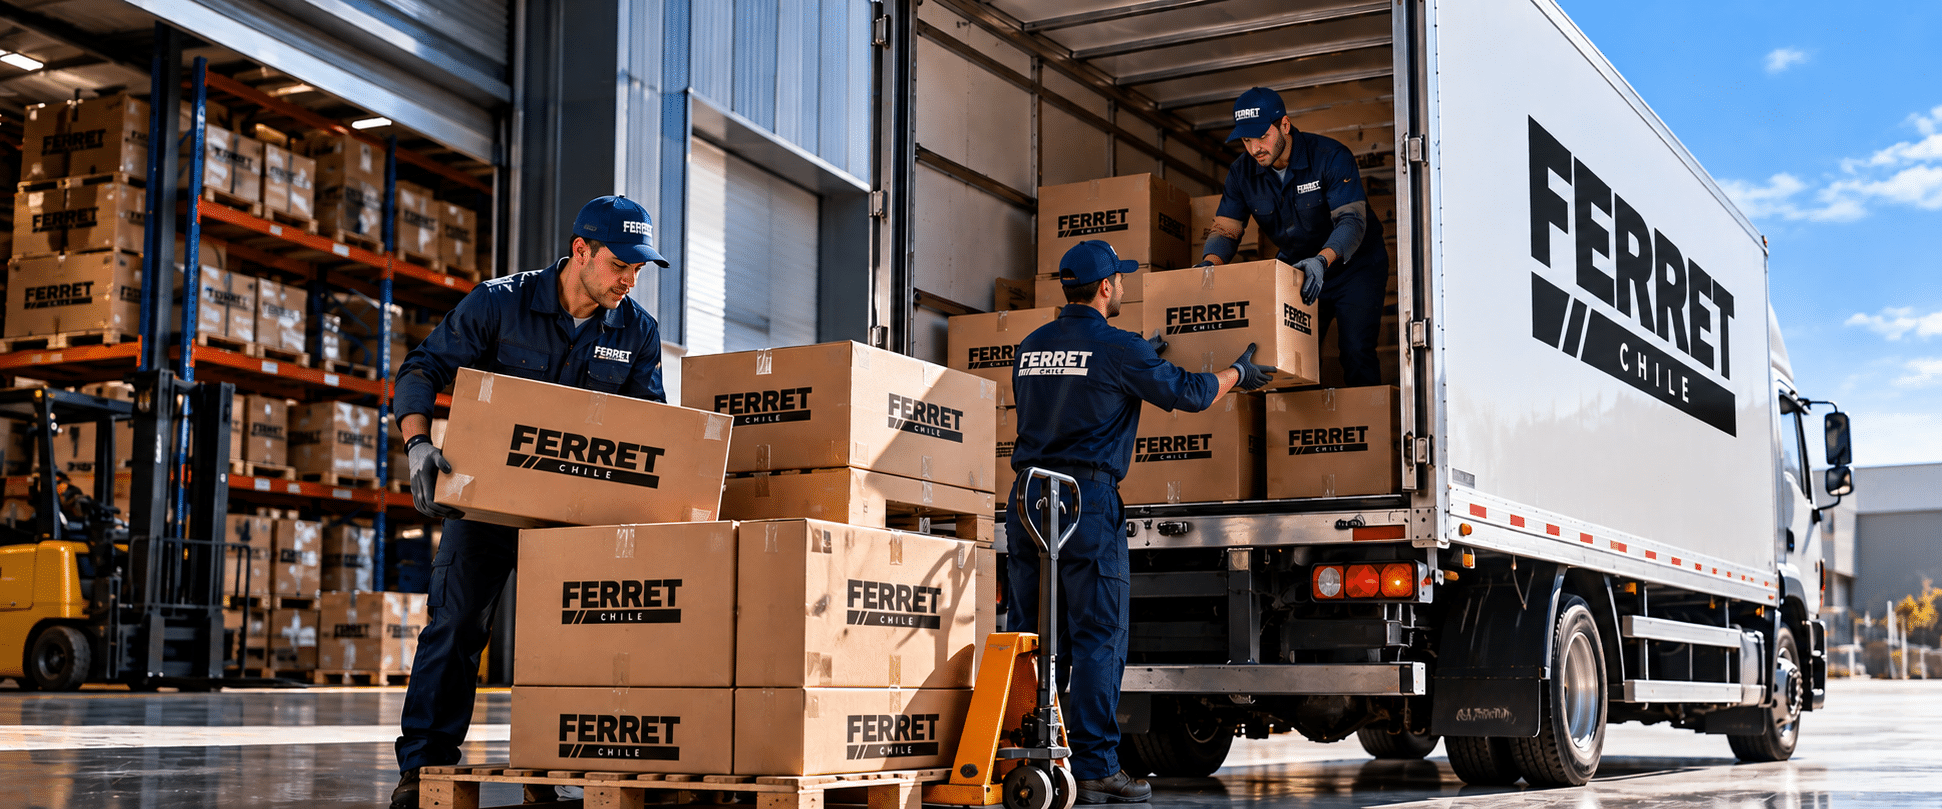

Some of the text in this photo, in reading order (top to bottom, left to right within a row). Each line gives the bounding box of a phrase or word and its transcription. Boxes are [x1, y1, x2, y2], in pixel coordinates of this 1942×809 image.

[1058, 208, 1129, 230] FERRET
[1528, 114, 1734, 381] FERRET
[25, 281, 94, 302] FERRET
[1166, 301, 1249, 325] FERRET
[1193, 323, 1223, 332] CHILE
[595, 346, 632, 361] FERRET
[1020, 351, 1093, 368] FERRET
[1619, 342, 1689, 403] CHILE
[714, 387, 812, 413] FERRET
[745, 414, 781, 424] CHILE
[888, 393, 963, 430] FERRET
[914, 425, 941, 437] CHILE
[1289, 426, 1368, 446] FERRET
[510, 424, 665, 473] FERRET
[1136, 433, 1212, 453] FERRET
[559, 464, 612, 479] CHILE
[562, 579, 682, 608] FERRET
[847, 579, 941, 614] FERRET
[601, 613, 643, 621] CHILE
[880, 615, 913, 626] CHILE
[559, 714, 681, 744] FERRET
[847, 713, 939, 743] FERRET
[598, 748, 640, 757] CHILE
[880, 746, 912, 755] CHILE
